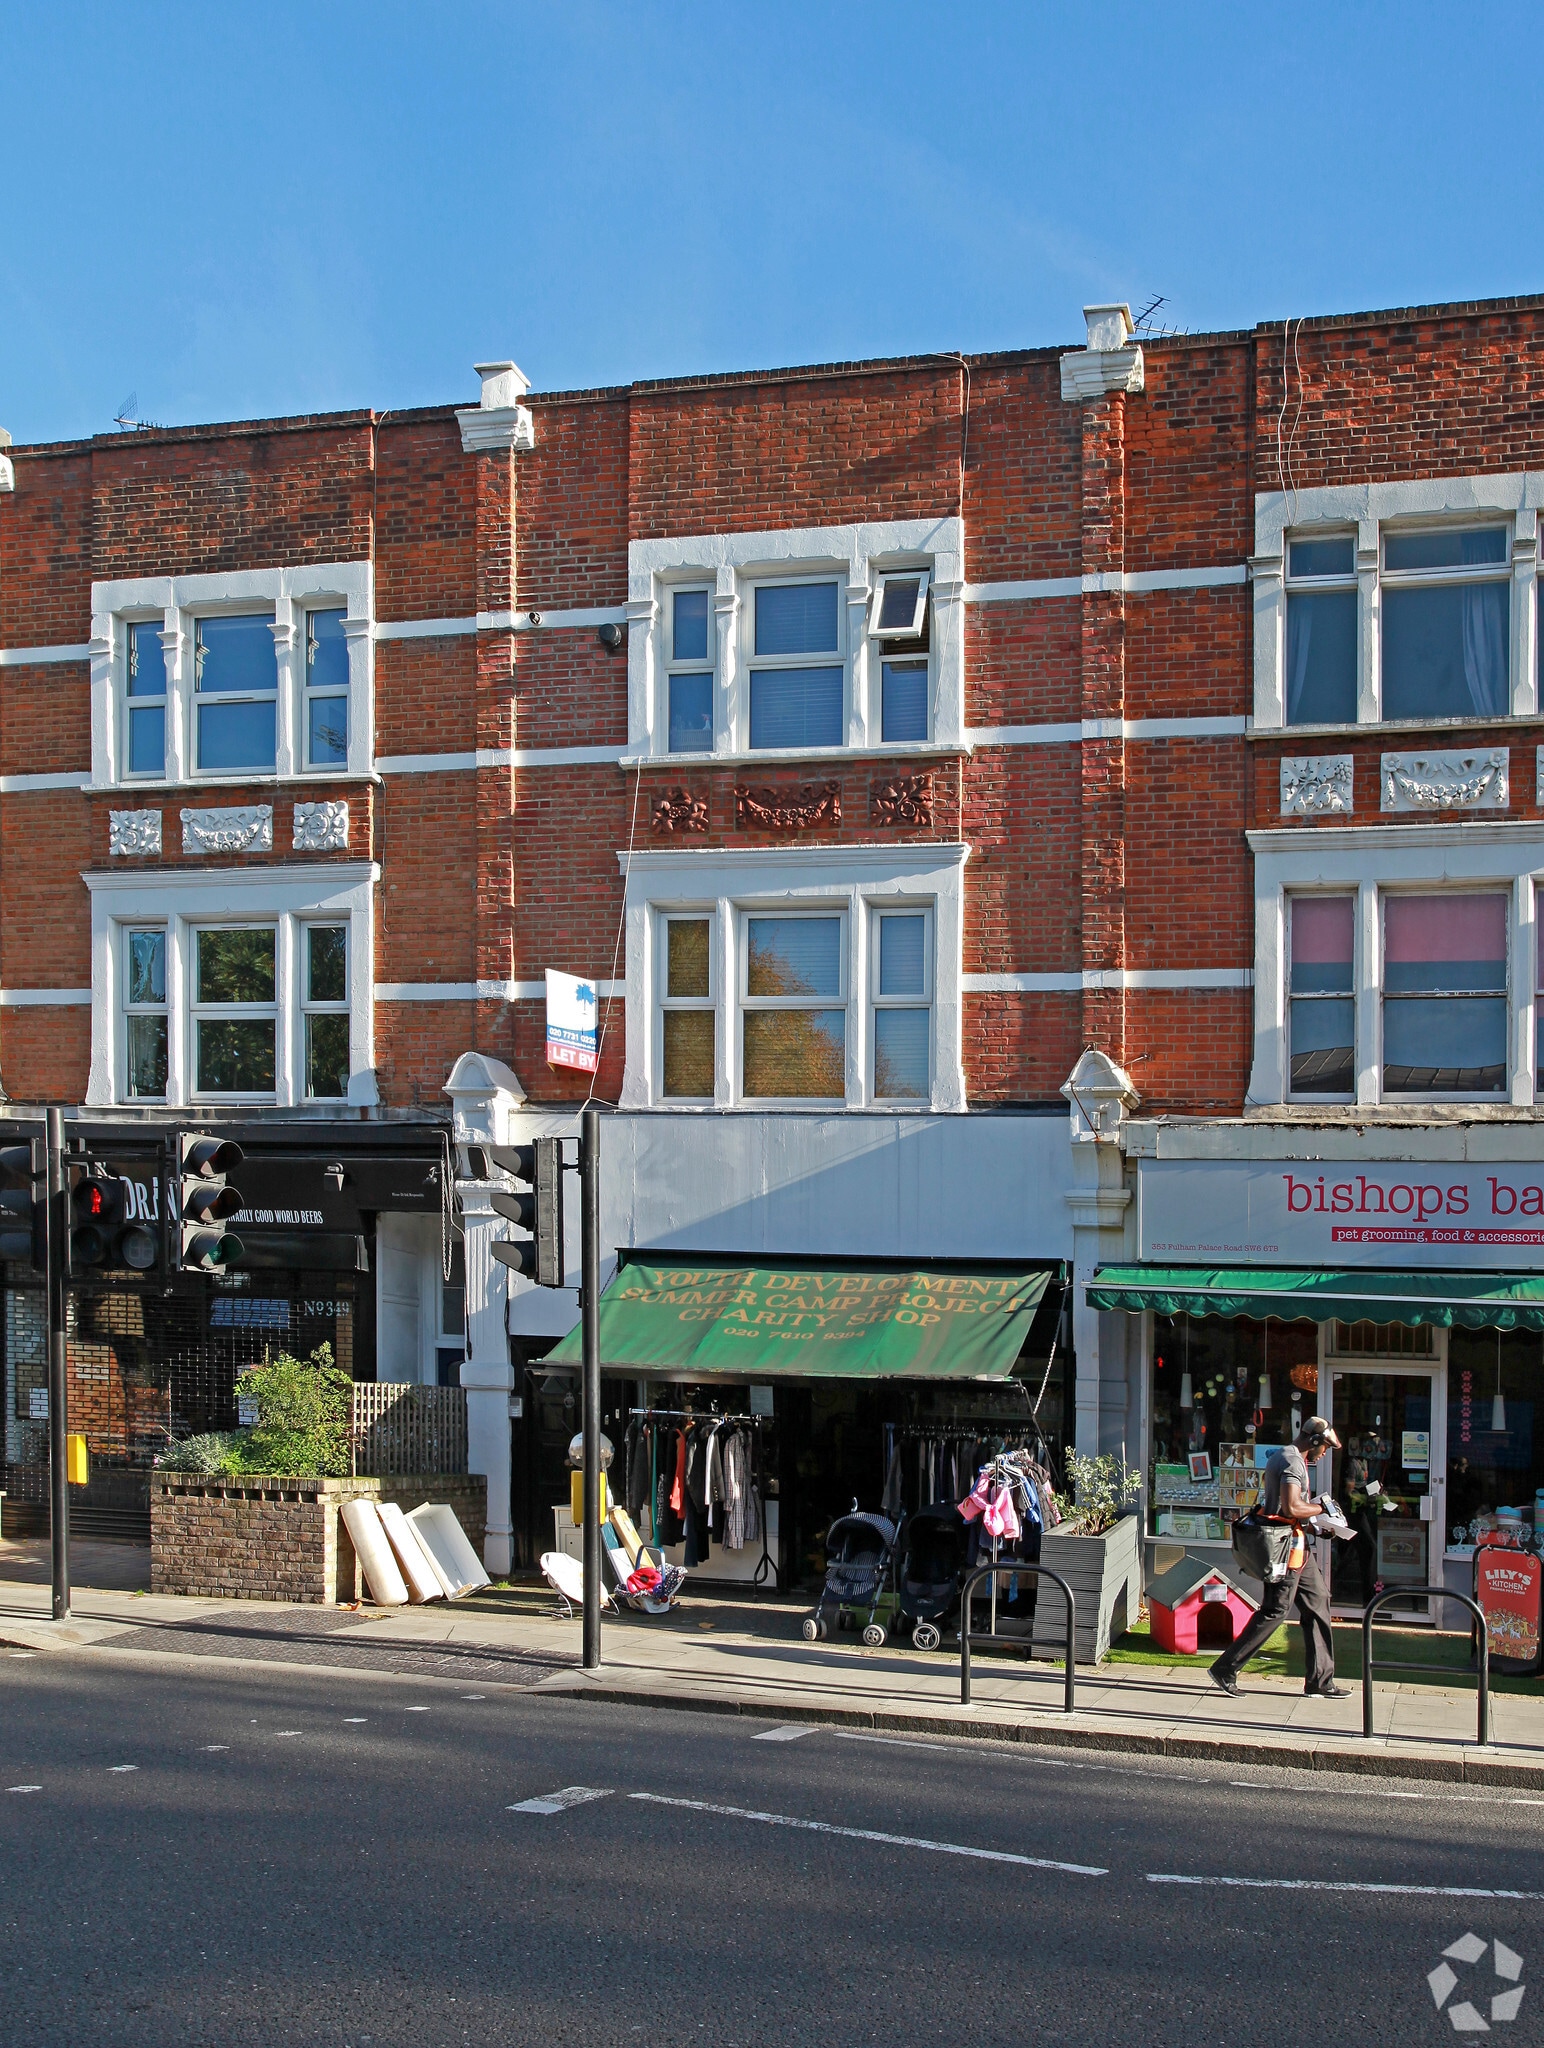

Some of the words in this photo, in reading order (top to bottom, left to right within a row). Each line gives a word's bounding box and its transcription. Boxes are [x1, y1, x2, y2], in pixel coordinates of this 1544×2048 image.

[552, 1046, 575, 1063] LET
[578, 1053, 595, 1068] BY
[1283, 1175, 1470, 1222] bishops
[254, 1209, 274, 1223] GOOD
[274, 1210, 300, 1224] WORLD
[300, 1211, 324, 1224] BEERS
[1337, 1230, 1358, 1241] pet
[1361, 1230, 1428, 1243] grooming,
[1431, 1230, 1460, 1241] food
[1463, 1231, 1475, 1242] &
[1151, 1243, 1166, 1251] 353
[1168, 1243, 1196, 1251] Fulham
[653, 1271, 758, 1287] YOUTH
[763, 1275, 1018, 1295] DEVELOPMENT
[619, 1287, 757, 1305] SUMMER
[765, 1294, 862, 1310] CAMP
[867, 1292, 1027, 1314] PROJECT
[678, 1306, 839, 1327] CHARITY
[846, 1309, 941, 1327] SHOP
[723, 1327, 760, 1338] 020
[768, 1331, 815, 1340] 7610
[1485, 1569, 1532, 1586] LILY'S
[1492, 1579, 1524, 1591] KITCHEN
